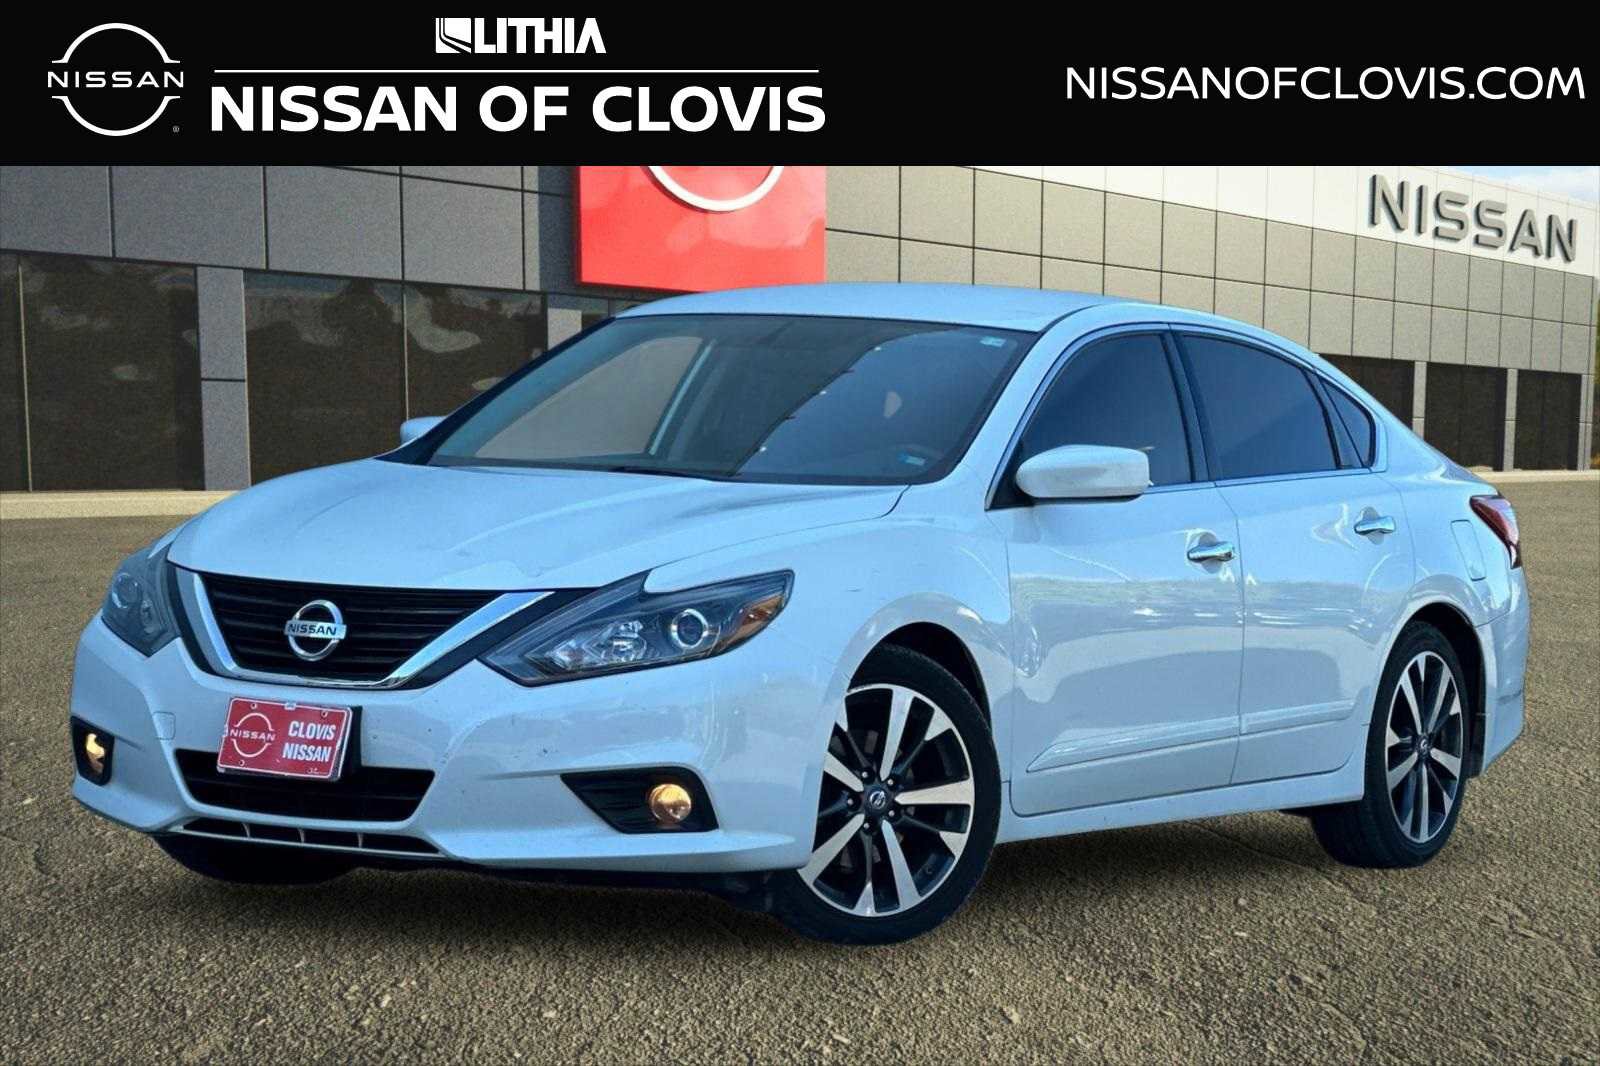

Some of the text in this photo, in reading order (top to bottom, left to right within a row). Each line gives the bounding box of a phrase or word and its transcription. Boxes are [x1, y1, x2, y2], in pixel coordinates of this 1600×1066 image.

[1369, 174, 1578, 263] NISSAN
[287, 623, 337, 636] NISSAN
[230, 728, 276, 742] NISSAN
[288, 720, 337, 741] CLOVIS
[282, 742, 332, 763] NISSAN
